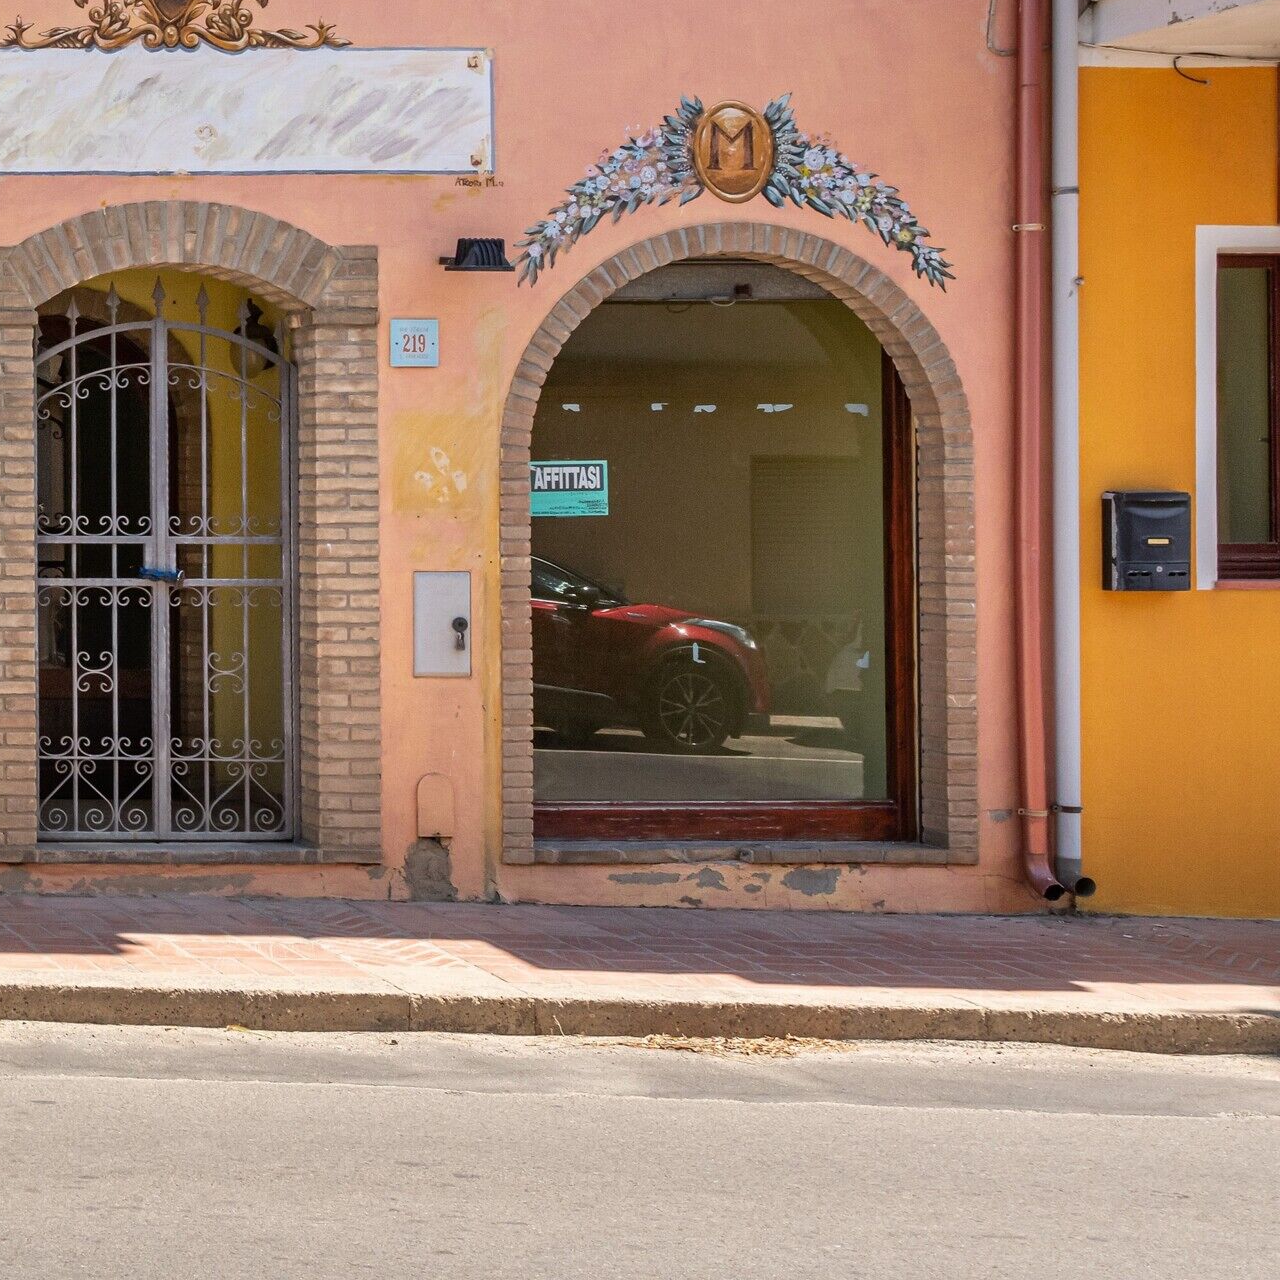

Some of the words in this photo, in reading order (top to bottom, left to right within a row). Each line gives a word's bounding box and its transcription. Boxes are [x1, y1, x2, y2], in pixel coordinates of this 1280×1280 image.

[707, 120, 758, 170] M
[402, 333, 426, 353] 219
[534, 465, 601, 490] AFFITTASI
